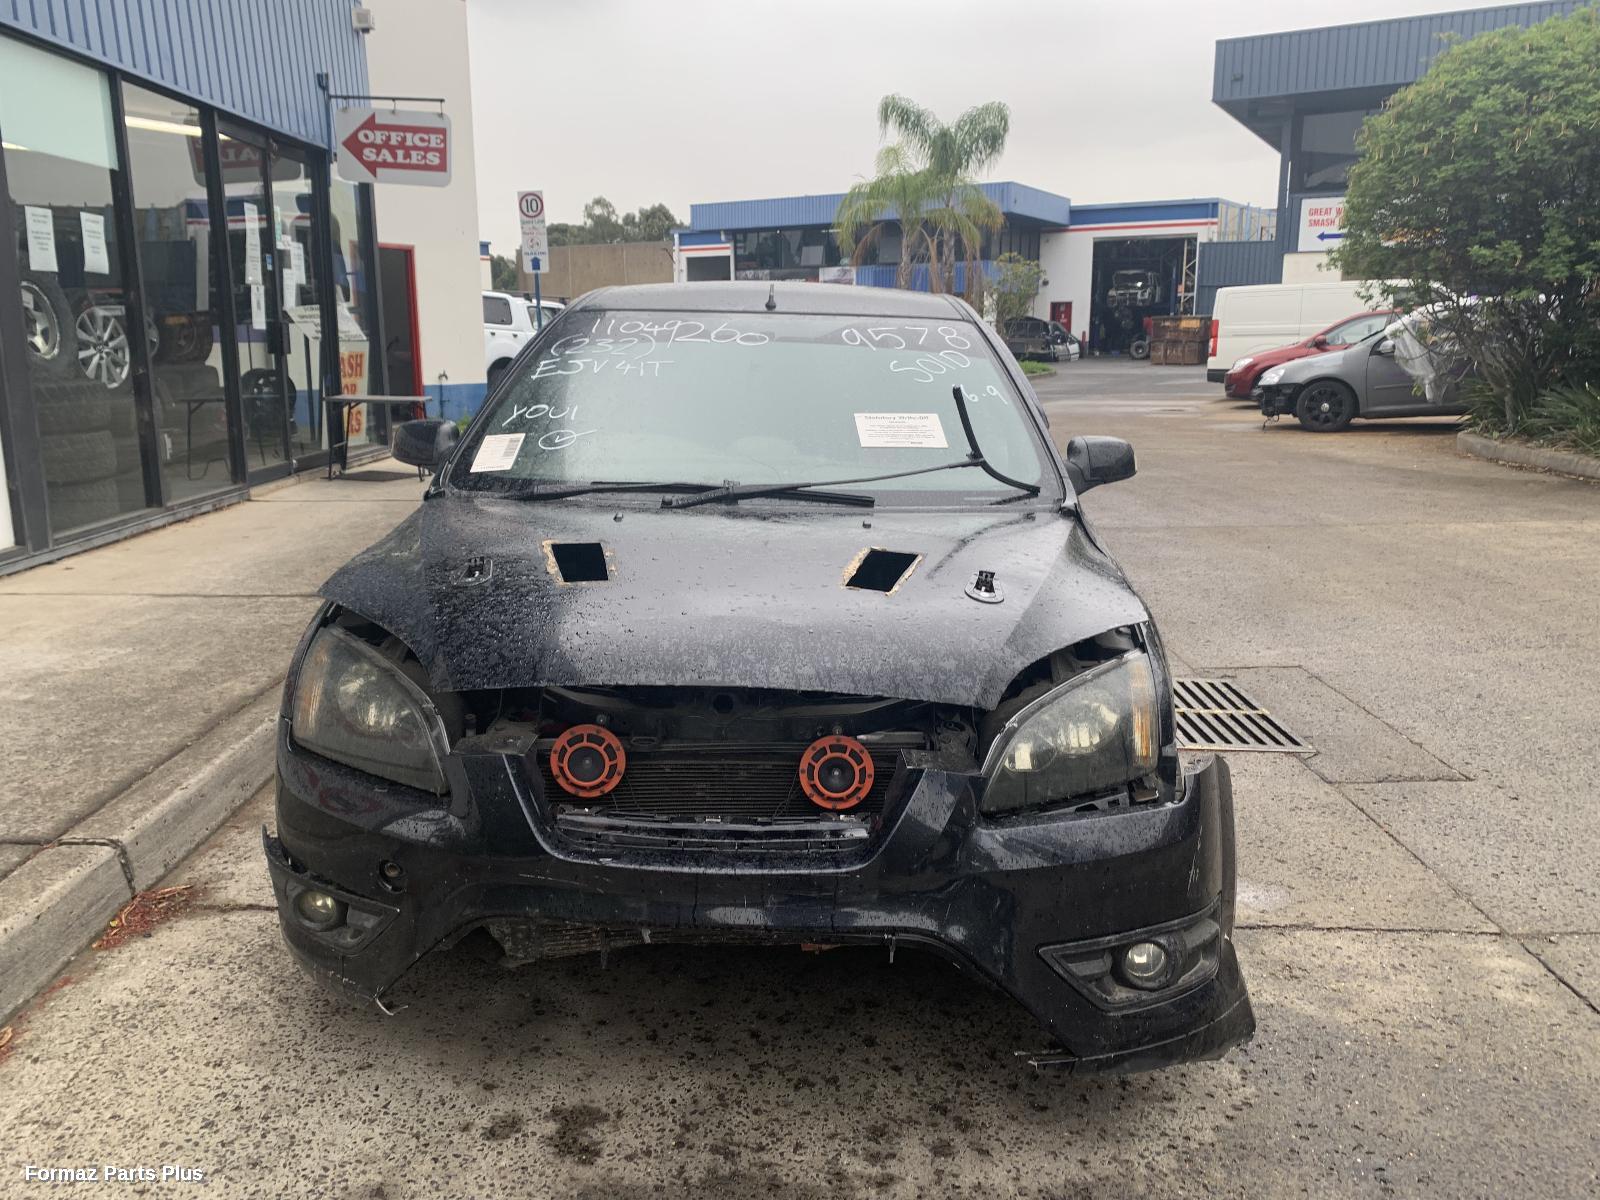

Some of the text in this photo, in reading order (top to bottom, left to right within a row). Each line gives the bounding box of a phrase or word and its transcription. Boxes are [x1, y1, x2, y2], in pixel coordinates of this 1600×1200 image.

[357, 129, 444, 148] OFFICE
[362, 147, 440, 166] SALES
[525, 198, 539, 213] 10
[1308, 207, 1332, 217] GREAT
[1308, 218, 1335, 227] SMASH
[841, 326, 971, 351] 9578
[340, 354, 364, 378] ASH
